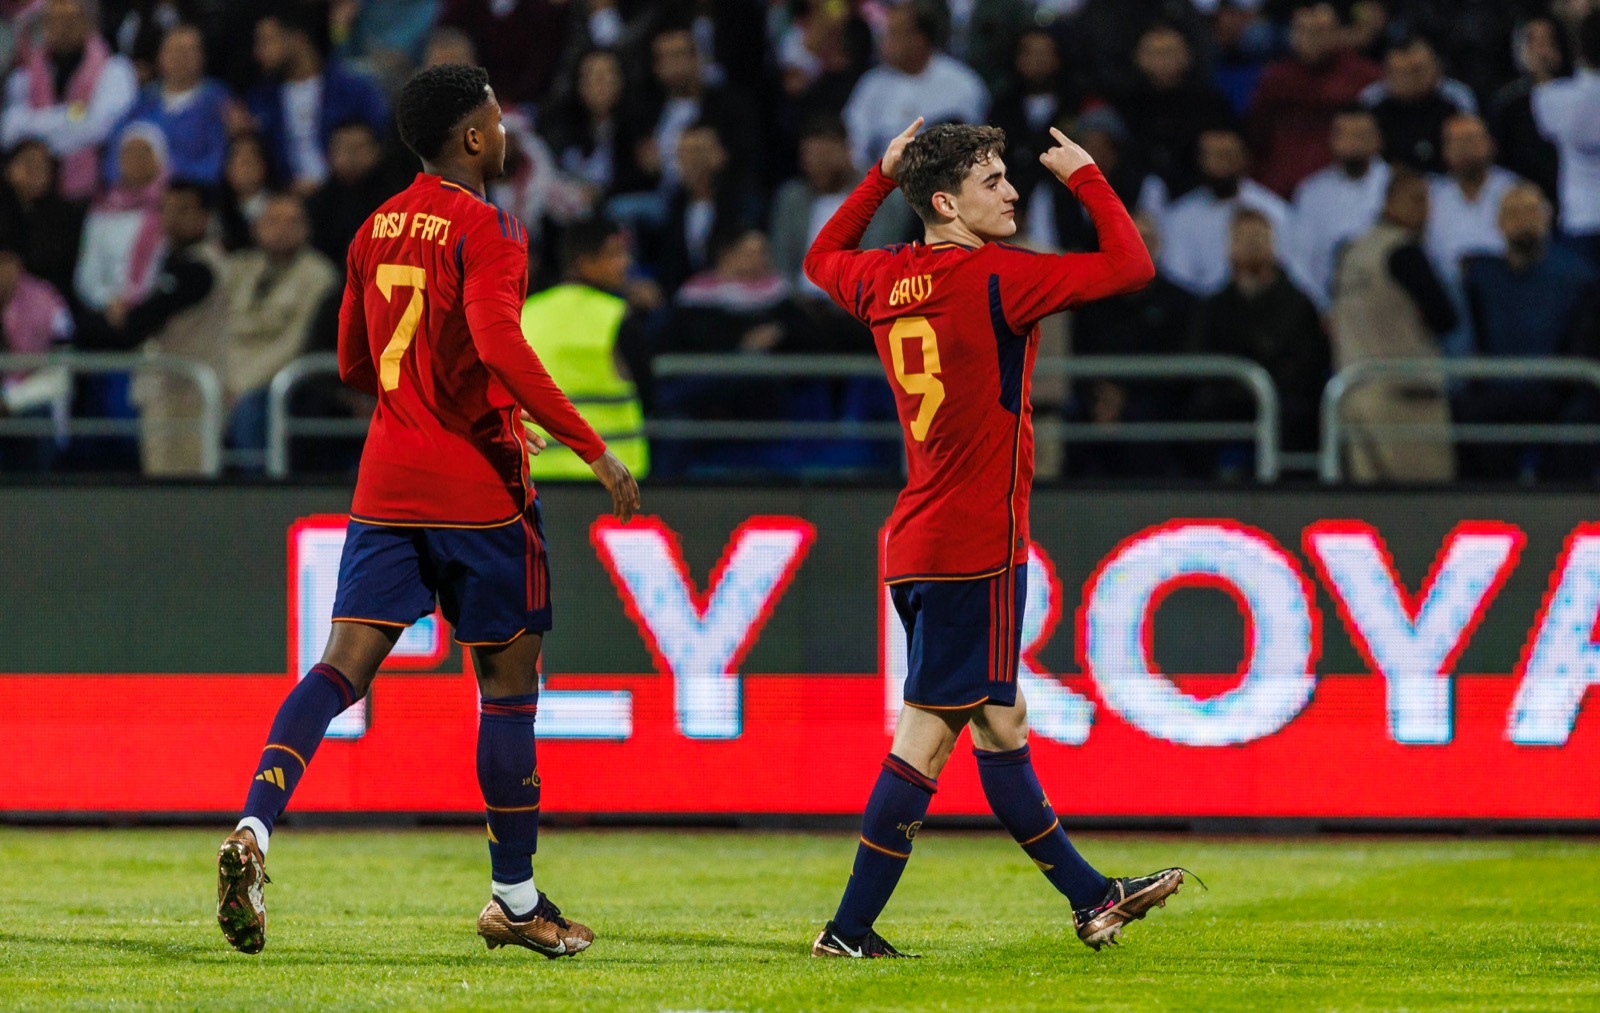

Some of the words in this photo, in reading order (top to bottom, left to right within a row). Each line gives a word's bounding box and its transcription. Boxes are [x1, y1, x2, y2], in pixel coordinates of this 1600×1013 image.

[410, 212, 451, 246] FATI
[376, 263, 426, 392] 7
[889, 274, 932, 306] GAVI
[888, 316, 945, 442] 9
